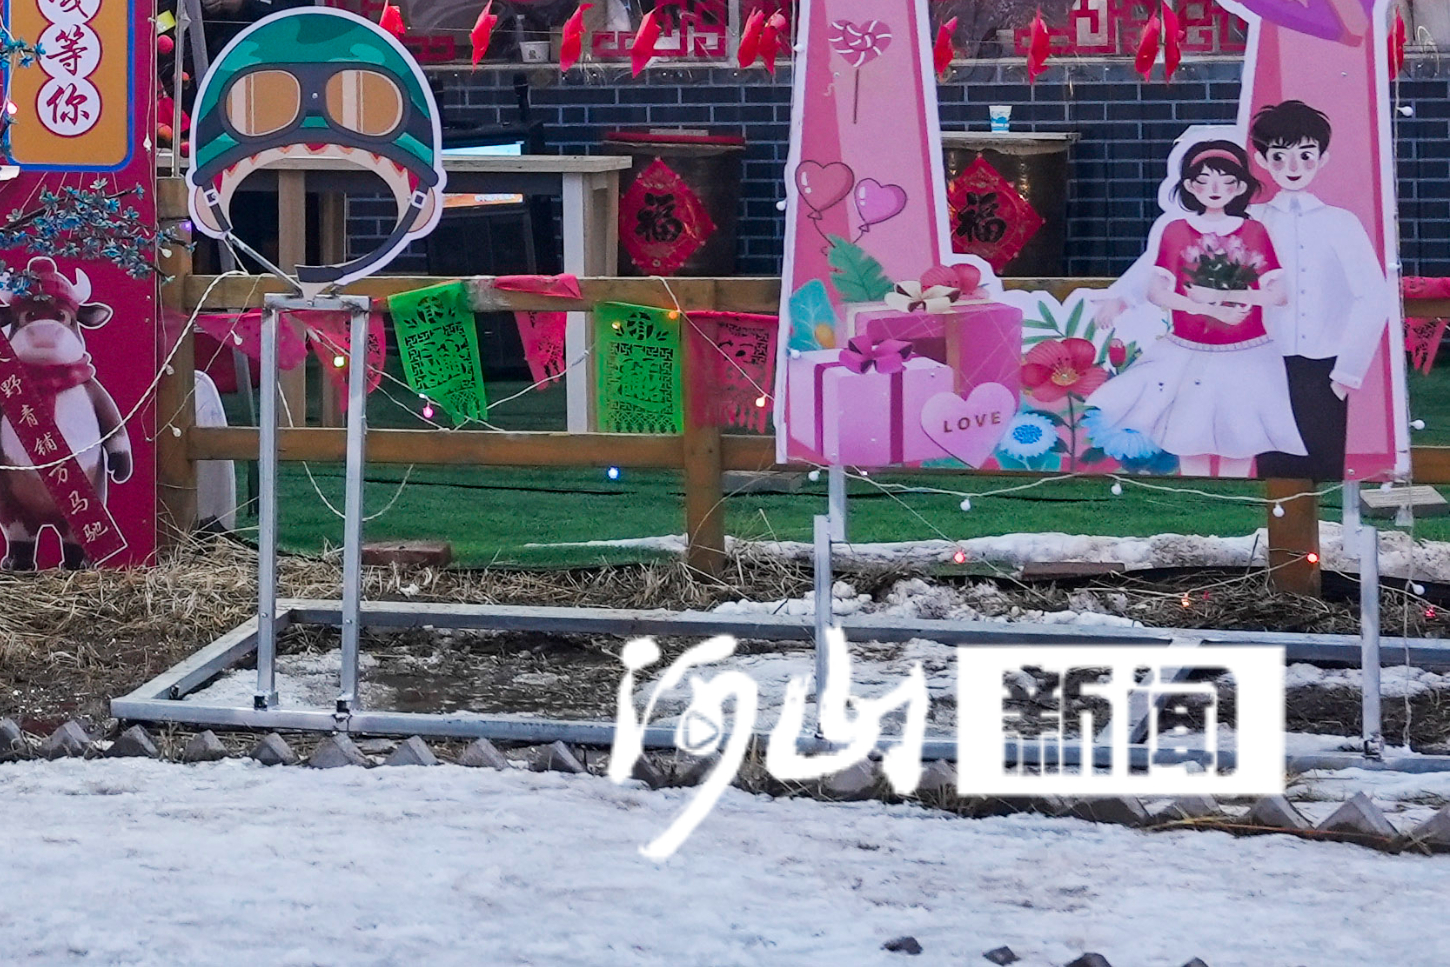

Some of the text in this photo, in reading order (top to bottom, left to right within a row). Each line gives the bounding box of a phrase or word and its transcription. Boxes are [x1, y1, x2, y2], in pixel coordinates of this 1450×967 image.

[635, 192, 683, 242] 福
[956, 191, 1007, 243] 福
[943, 410, 1002, 434] LOVE
